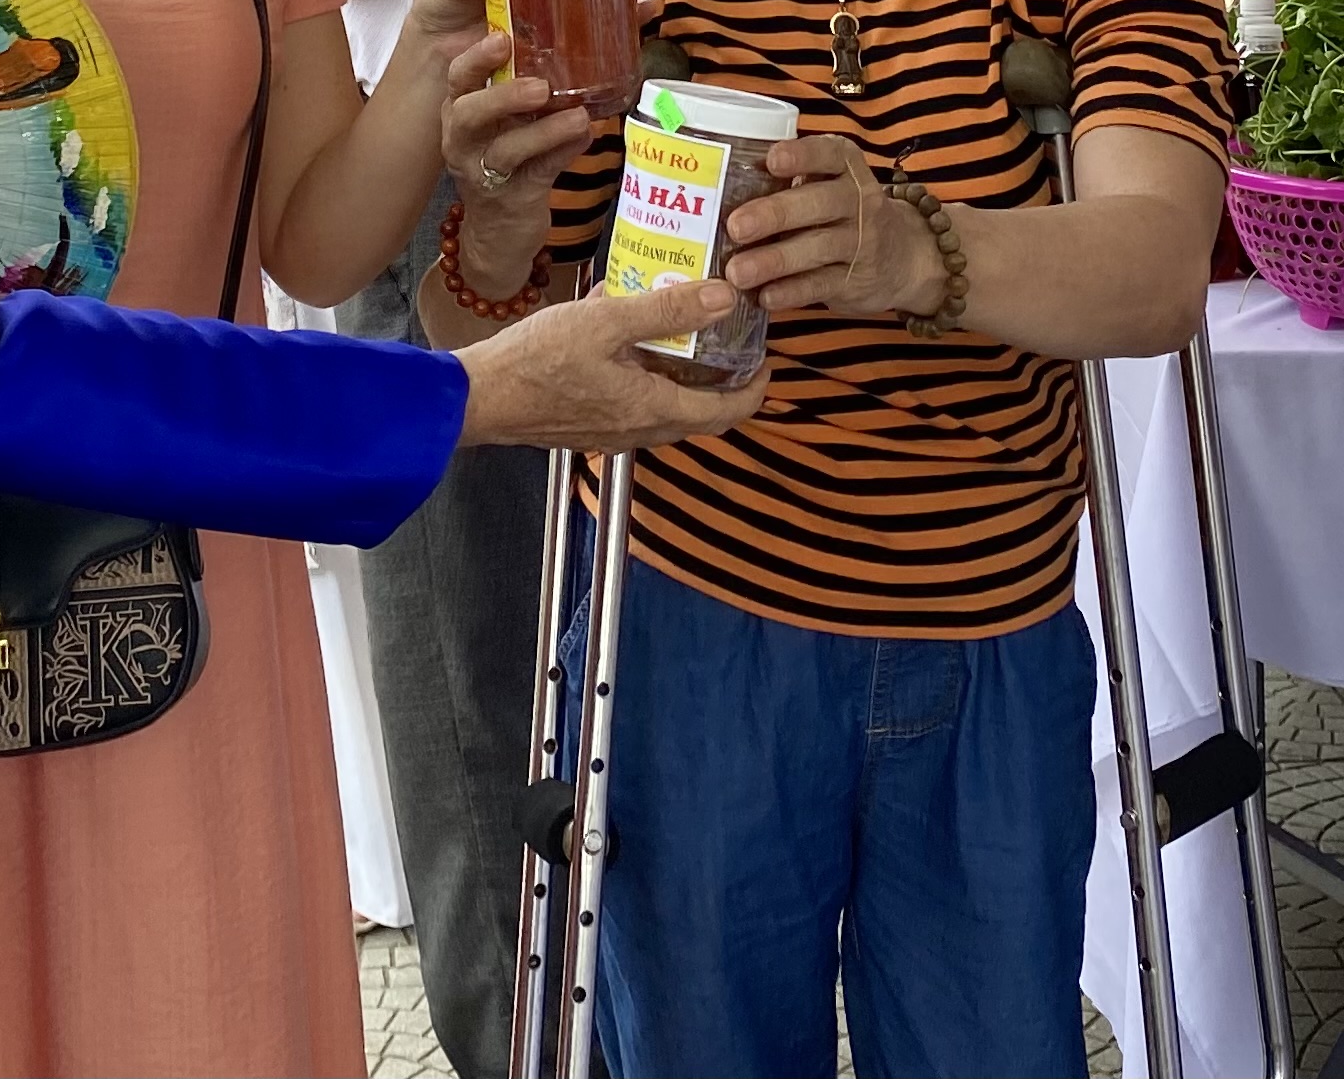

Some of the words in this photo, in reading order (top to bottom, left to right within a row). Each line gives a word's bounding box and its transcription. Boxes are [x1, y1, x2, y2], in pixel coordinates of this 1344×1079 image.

[629, 139, 663, 164] MẮM
[669, 153, 700, 173] RÒ
[623, 172, 642, 201] BÀ
[648, 184, 706, 217] HẢI
[644, 211, 681, 233] HÒA)
[668, 247, 696, 268] TIẾNG
